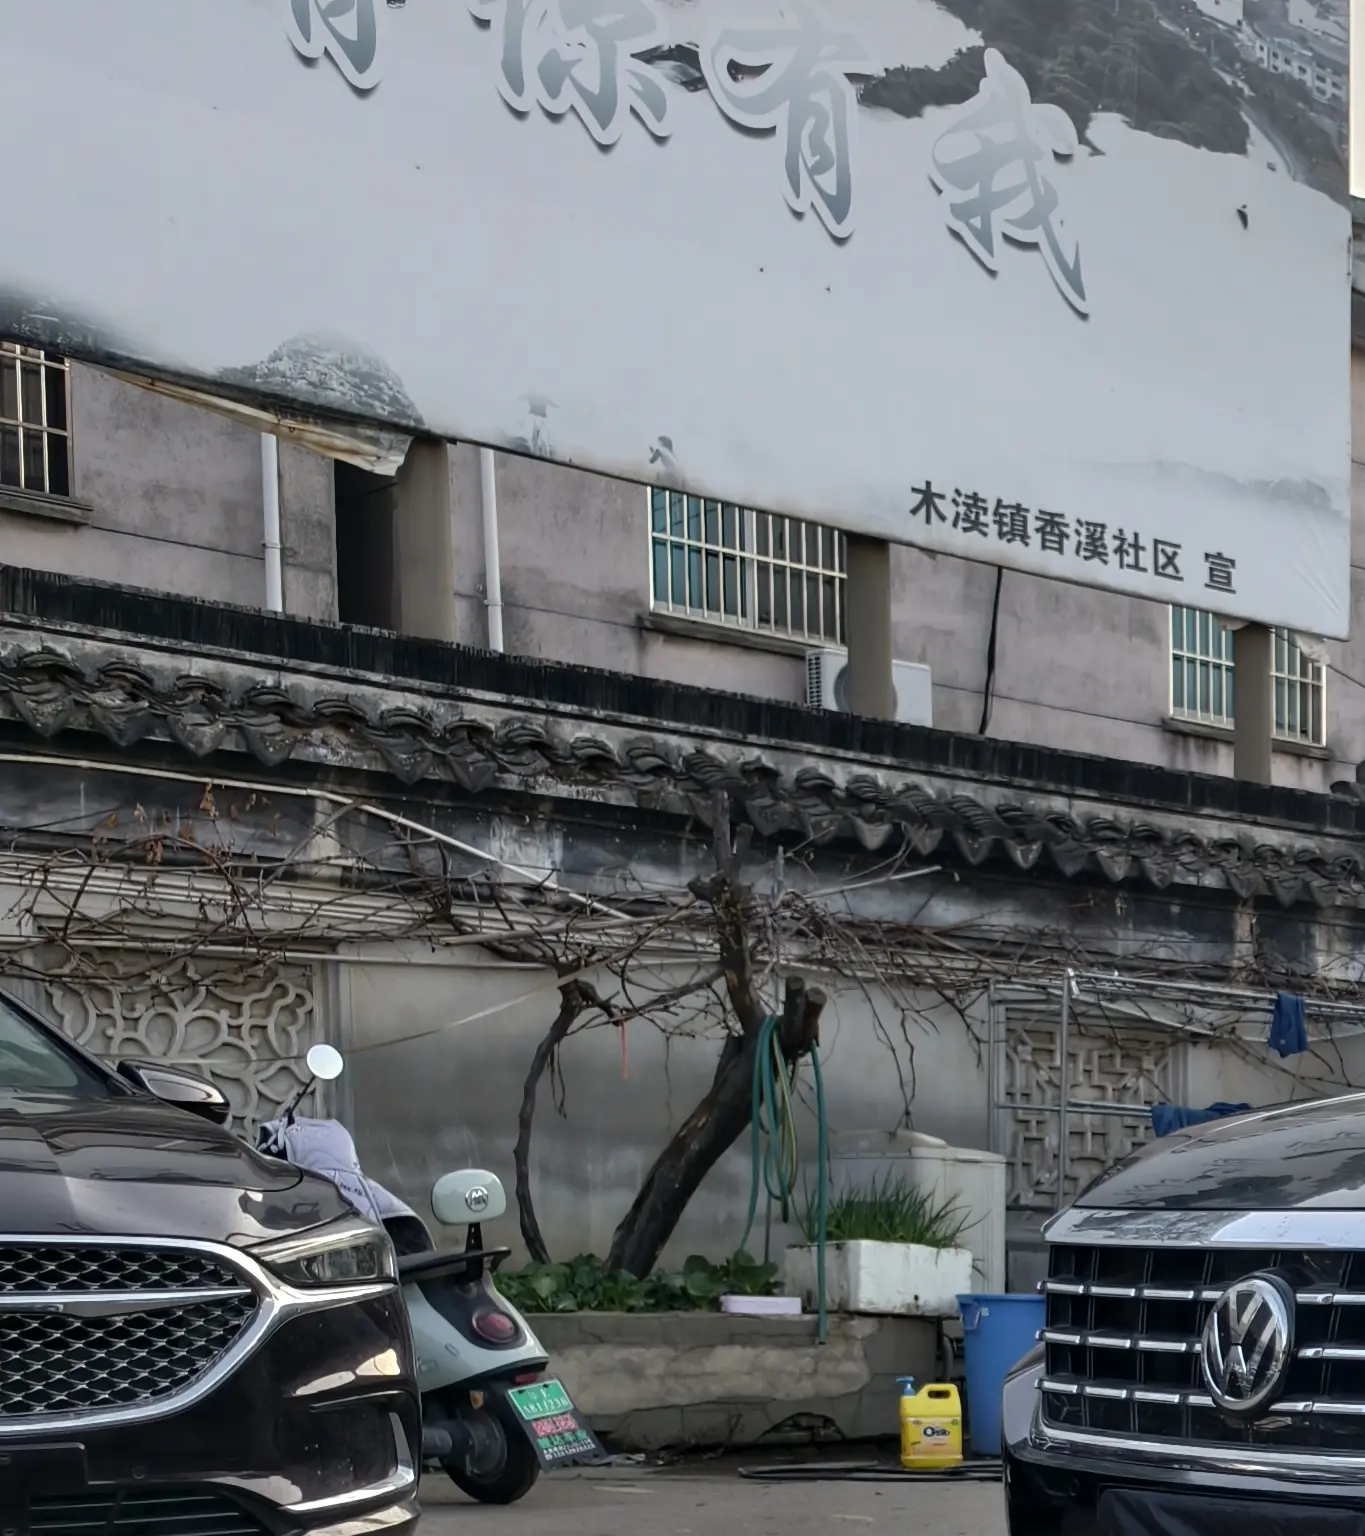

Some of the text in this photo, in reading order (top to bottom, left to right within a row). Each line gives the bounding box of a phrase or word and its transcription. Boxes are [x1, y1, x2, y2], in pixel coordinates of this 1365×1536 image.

[908, 479, 1237, 595] 木渎镇香溪社区 宣
